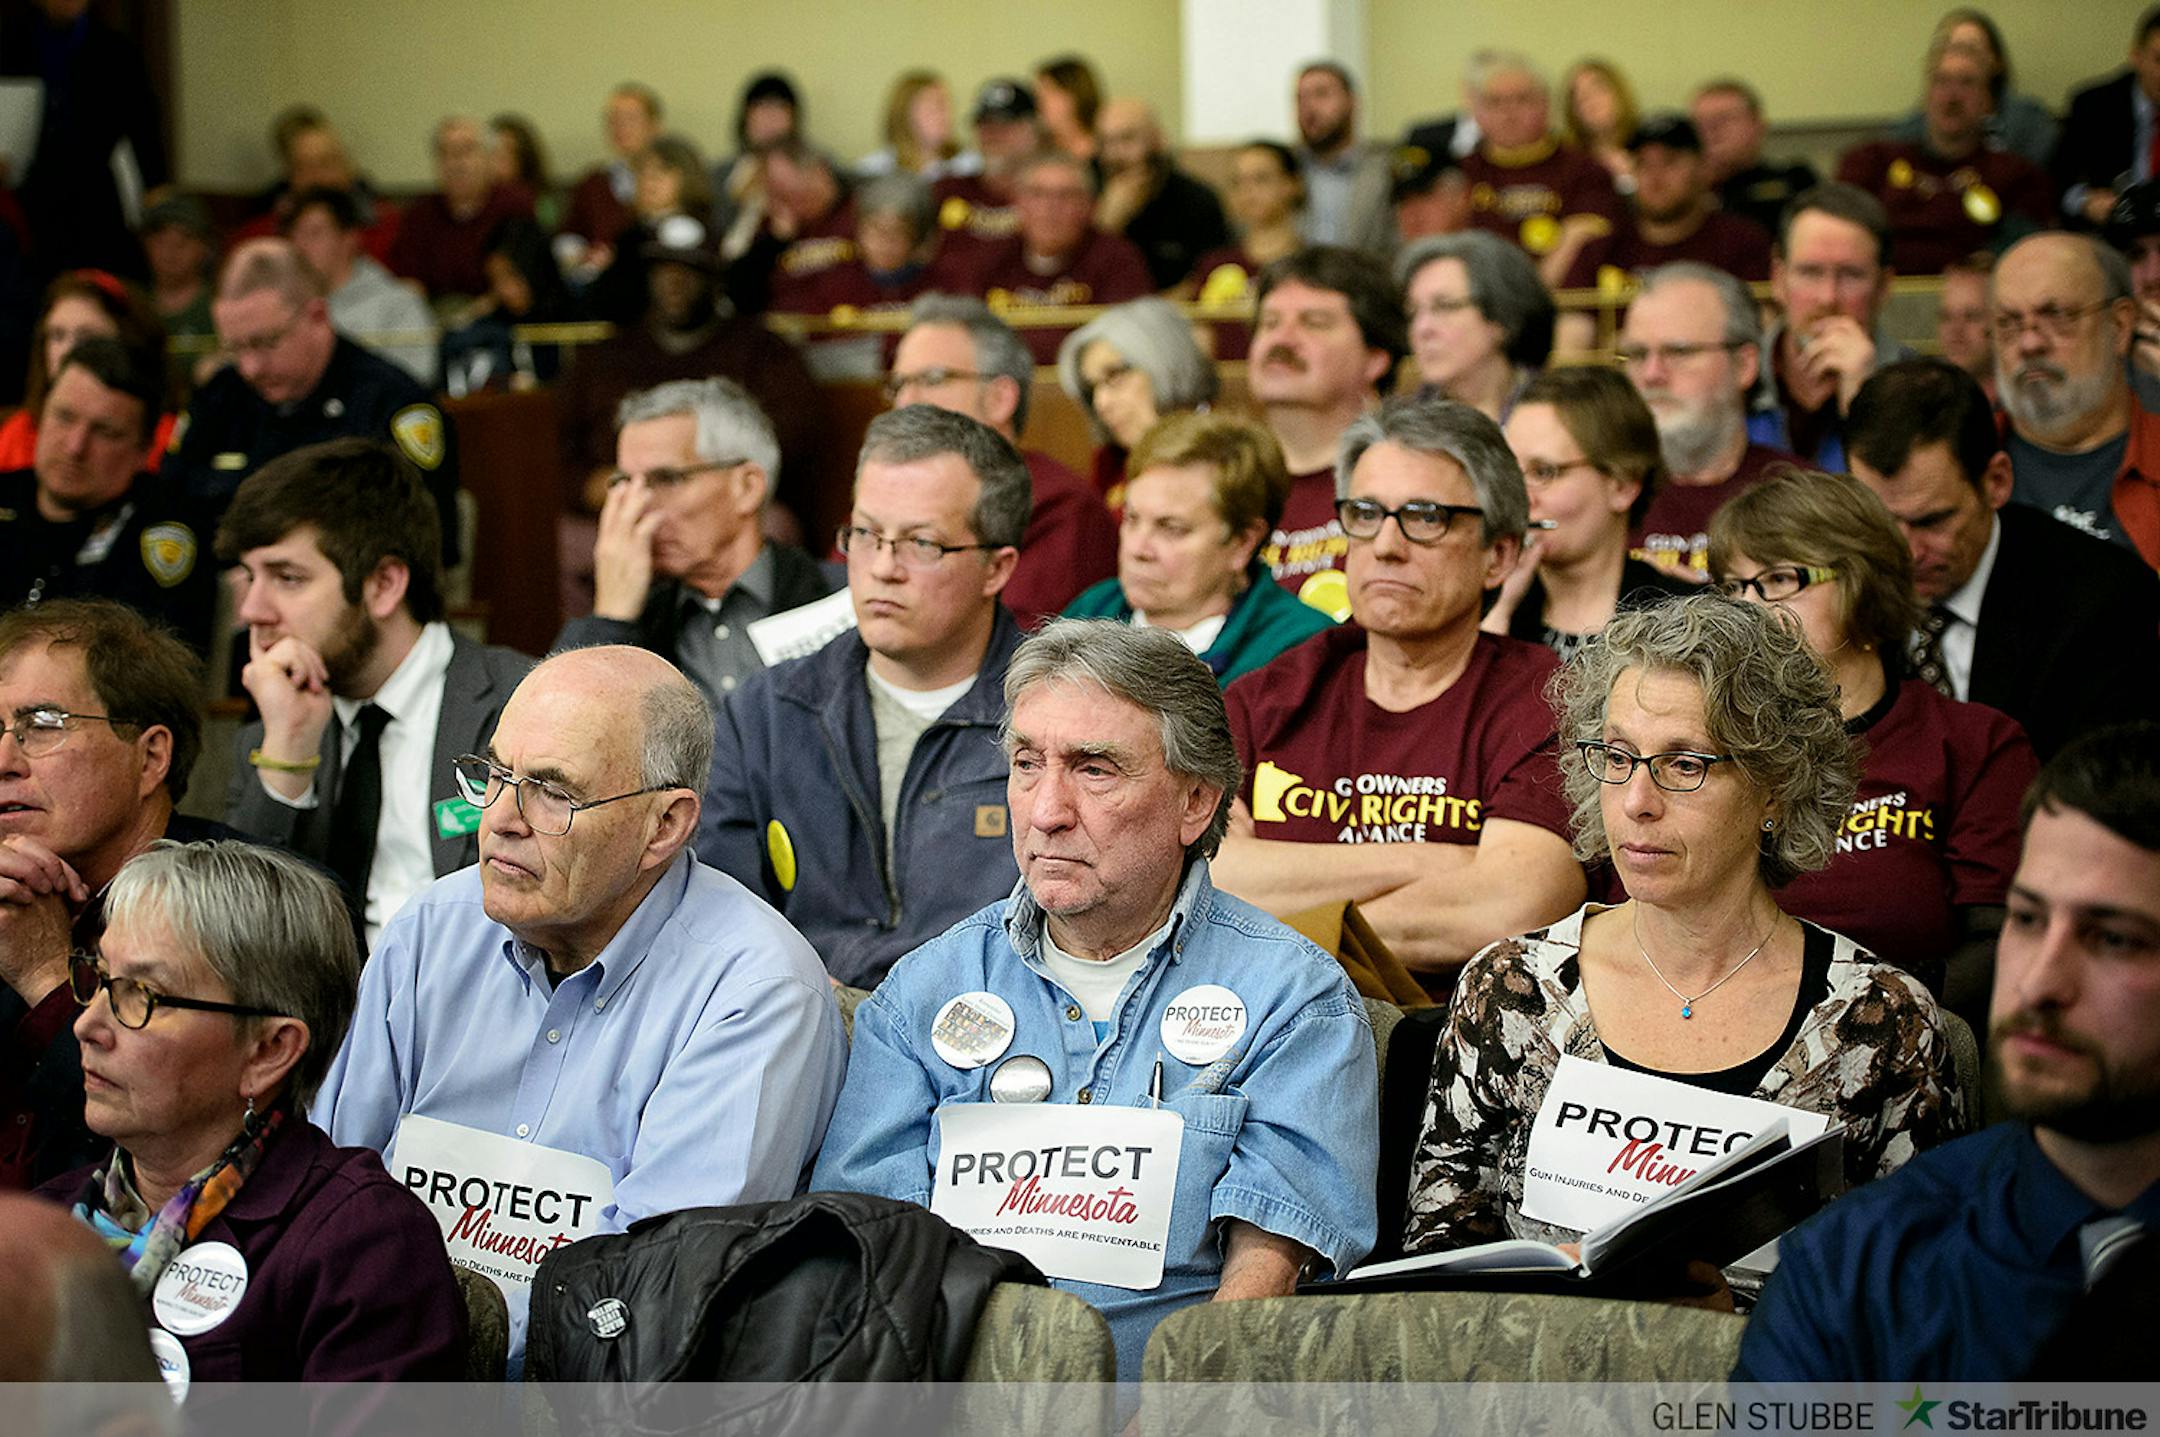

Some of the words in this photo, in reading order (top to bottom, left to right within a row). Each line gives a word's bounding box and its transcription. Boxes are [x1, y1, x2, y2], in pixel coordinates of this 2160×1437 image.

[1356, 773, 1447, 796] OWNERS
[1285, 786, 1357, 828] CIV
[1361, 793, 1484, 831] RIGHTS
[1851, 790, 1907, 815] NERS
[1164, 1005, 1244, 1022] PROTECT
[1555, 1101, 1754, 1157] PROTEC
[951, 1145, 1153, 1187] PROTECT
[404, 1166, 592, 1228] PROTECT
[995, 1174, 1140, 1224] Minnesota
[1529, 1167, 1553, 1181] GUN
[1554, 1173, 1604, 1193] INJURIES
[1605, 1187, 1630, 1200] AND
[446, 1204, 573, 1265] Minnesot
[993, 1226, 1013, 1235] AND
[1014, 1226, 1055, 1237] DEATHS
[1056, 1229, 1079, 1240] ARE
[1081, 1232, 1161, 1252] PREVENTABLE
[165, 1261, 245, 1293] PROTECT
[469, 1260, 502, 1277] DEATHS
[503, 1271, 522, 1283] ARE
